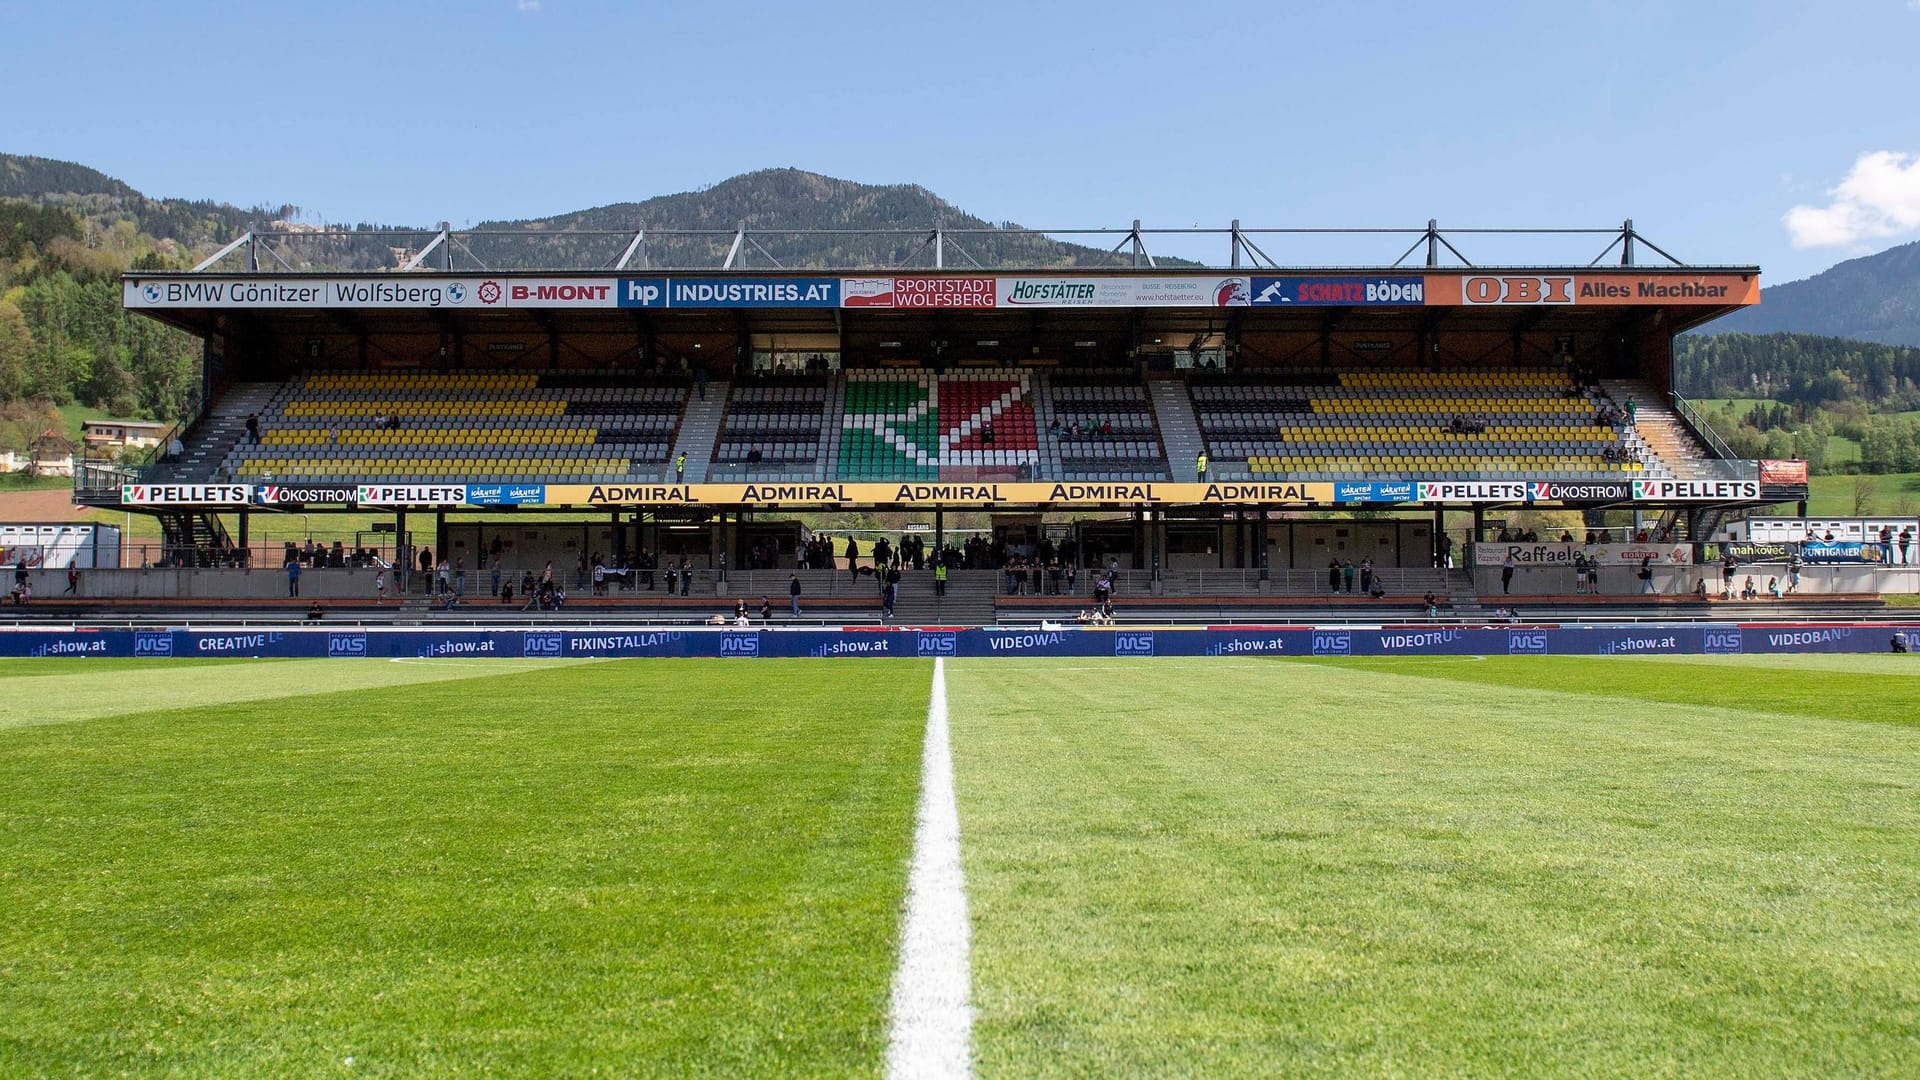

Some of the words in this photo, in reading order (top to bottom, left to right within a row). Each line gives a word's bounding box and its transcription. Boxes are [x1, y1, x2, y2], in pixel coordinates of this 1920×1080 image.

[511, 285, 610, 301] B-MONT
[627, 281, 659, 306] hp
[675, 284, 832, 302] INDUSTRIES.AT
[896, 279, 994, 292] SPORTSTADT
[1298, 283, 1365, 302] SCHATZ
[1366, 280, 1423, 302] BÖDEN
[1465, 277, 1572, 304] OBI
[1579, 283, 1631, 298] Alles
[1637, 282, 1728, 298] Machbar
[167, 283, 223, 302] BMW
[230, 282, 320, 303] Gönitzer
[336, 282, 442, 307] Wolfsberg
[896, 293, 994, 306] WOLFSBERG
[150, 486, 246, 502] PELLETS
[279, 485, 358, 502] ÖKOSTROM
[382, 487, 465, 501] PELLETS
[588, 485, 699, 503] ADMIRAL
[741, 484, 853, 503] ADMIRAL
[895, 484, 1007, 502] ADMIRAL
[1049, 484, 1161, 502] ADMIRAL
[1203, 484, 1315, 502] ADMIRAL
[1441, 484, 1525, 499] PELLETS
[1549, 483, 1629, 499] ÖKOSTROM
[1661, 482, 1757, 499] PELLETS
[1508, 545, 1582, 562] Raffaele
[1729, 544, 1785, 556] mahkovec
[1801, 547, 1860, 558] PUNTIGAMER
[199, 634, 265, 650] CREATIVE
[990, 631, 1073, 650] VIDEOWAL
